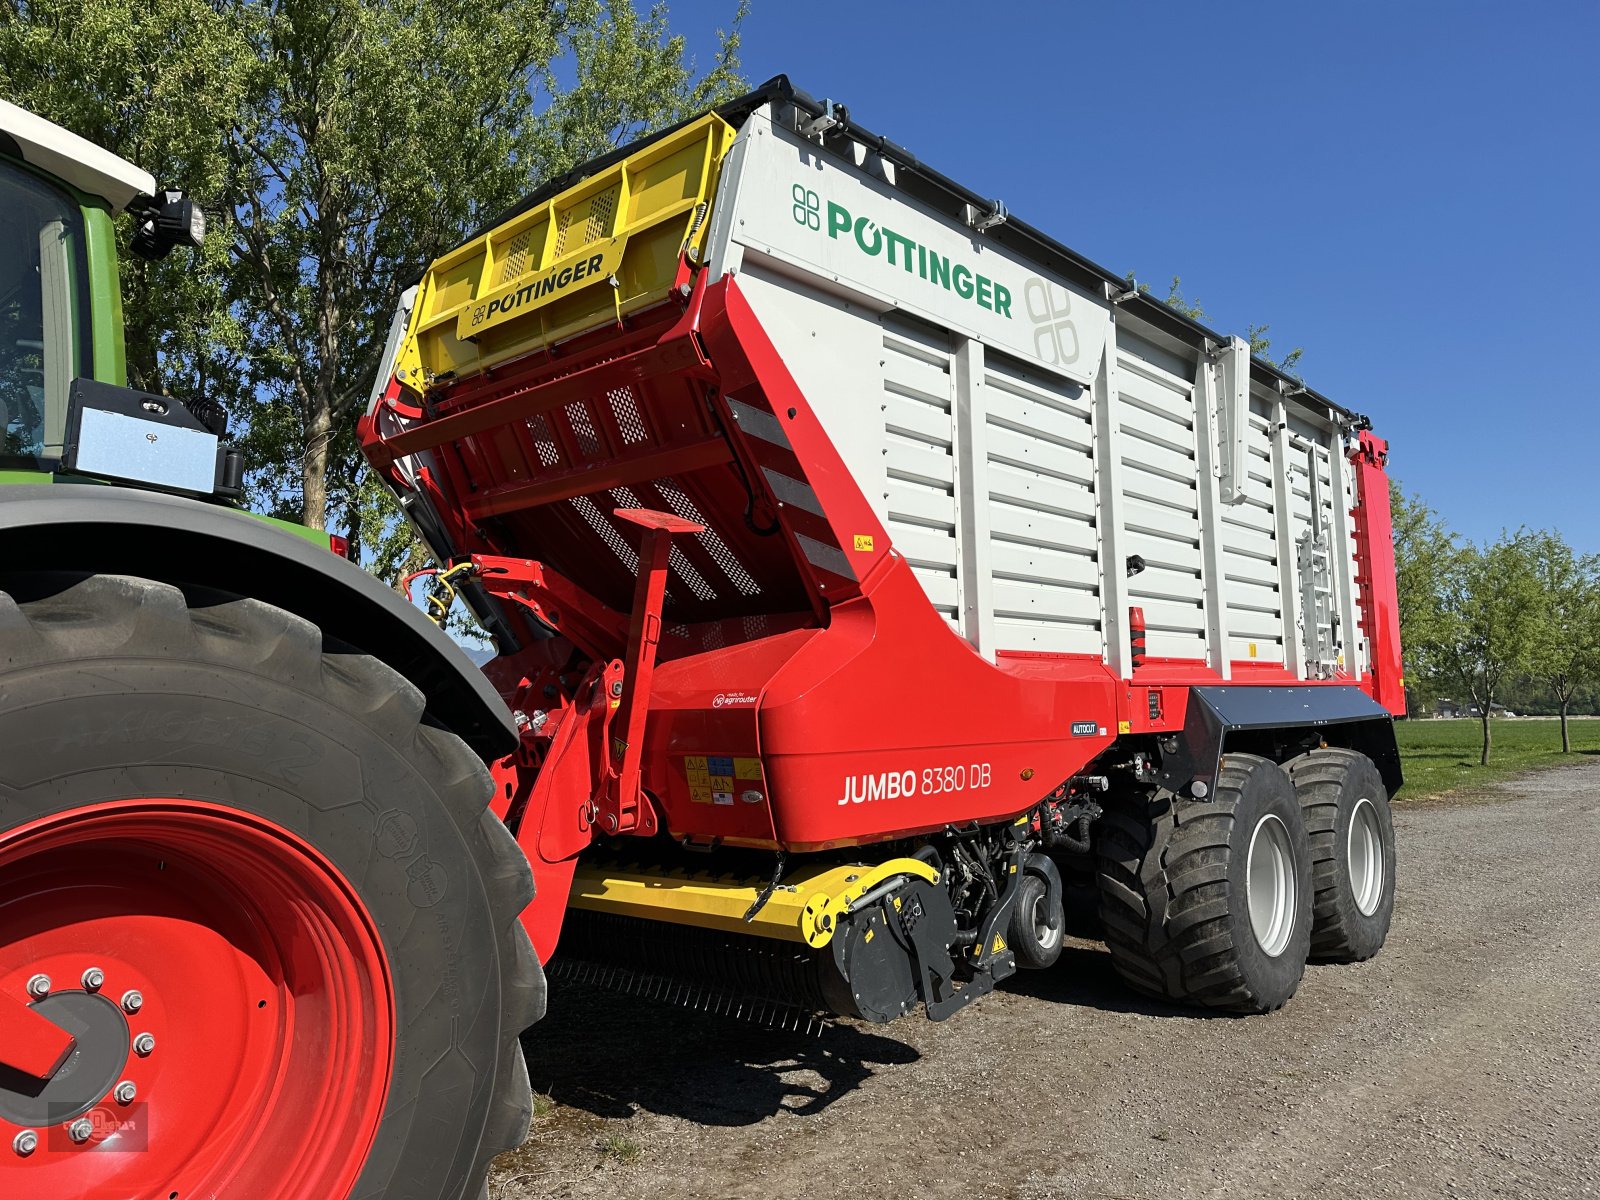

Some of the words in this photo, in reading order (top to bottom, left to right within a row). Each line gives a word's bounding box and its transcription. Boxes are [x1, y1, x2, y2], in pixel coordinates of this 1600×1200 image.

[827, 199, 1013, 320] PÖTTINGER
[485, 253, 604, 320] PÖTTINGER
[724, 696, 757, 705] agrirouter
[1073, 724, 1096, 734] AUTOCUT
[838, 770, 917, 806] JUMBO
[921, 765, 966, 795] 8380
[970, 763, 992, 789] DB
